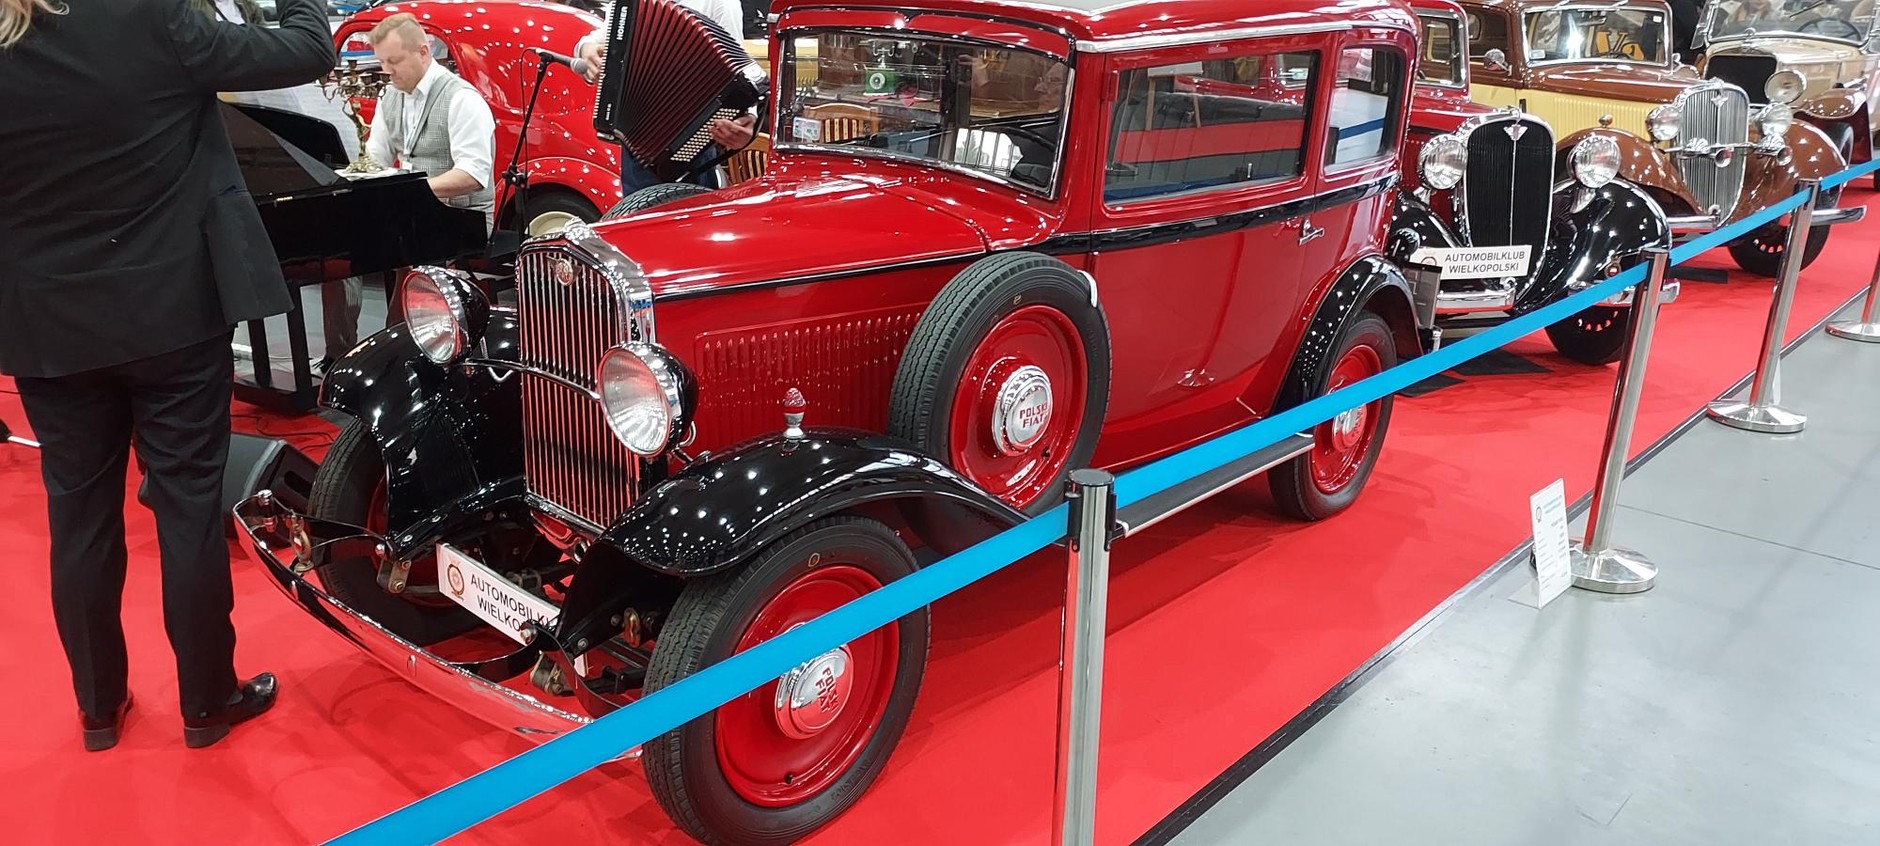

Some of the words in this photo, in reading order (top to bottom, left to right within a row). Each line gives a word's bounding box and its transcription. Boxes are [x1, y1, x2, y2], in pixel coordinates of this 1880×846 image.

[616, 6, 628, 40] HOHNER
[1445, 251, 1525, 262] AUTOMOBILKLUB
[1449, 263, 1519, 273] WIELKOPOLSKI
[1020, 402, 1048, 419] POLSKI
[1022, 412, 1046, 428] FIAT
[477, 595, 521, 632] WIELKO
[815, 679, 829, 712] FIAT
[823, 667, 840, 713] POLSKI
